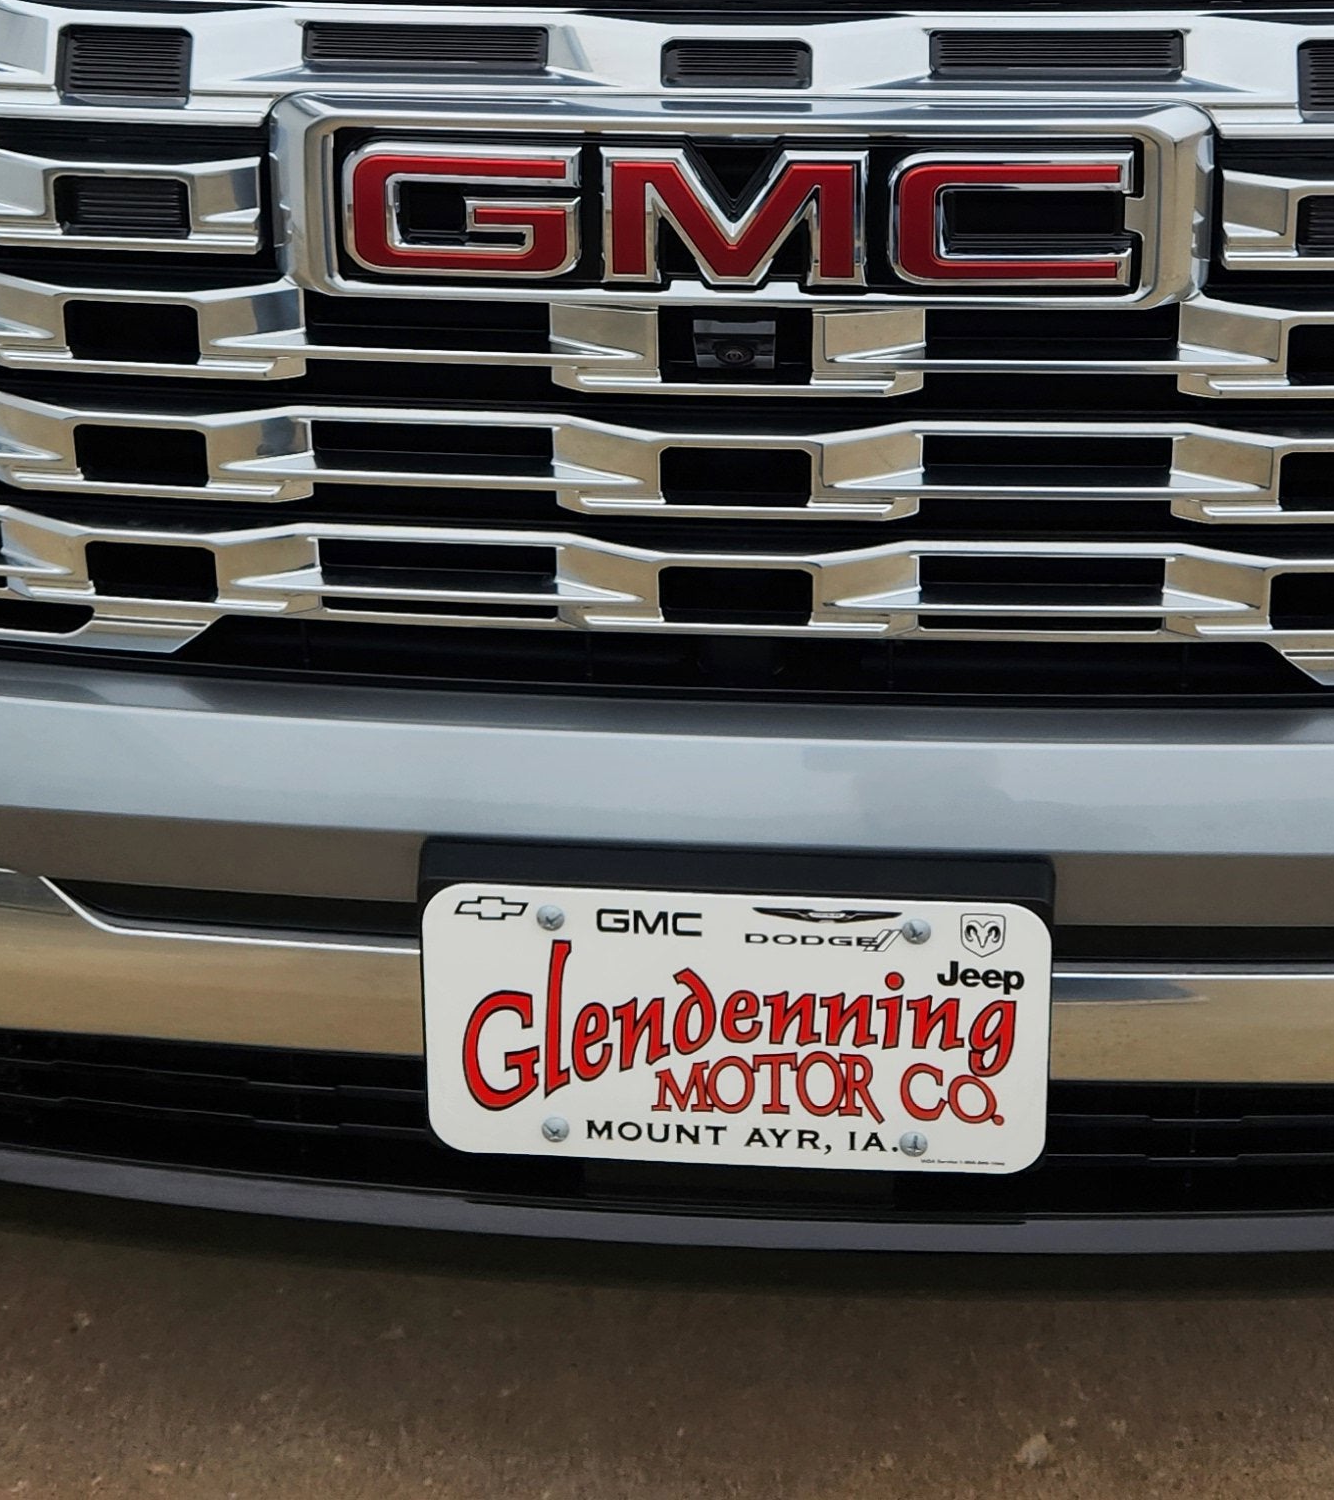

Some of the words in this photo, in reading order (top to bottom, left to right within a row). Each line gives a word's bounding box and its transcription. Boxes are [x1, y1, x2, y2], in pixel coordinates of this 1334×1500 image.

[342, 141, 1136, 287] GMC
[596, 908, 702, 937] GMC
[744, 933, 878, 947] DODGE
[937, 960, 1025, 995] Jeep
[463, 939, 1017, 1111] Glendenning
[651, 1050, 885, 1124] MOTOR
[899, 1062, 1005, 1126] CO.
[586, 1119, 727, 1145] MOUNT
[744, 1127, 833, 1154] AYR,
[848, 1131, 899, 1152] IA.
